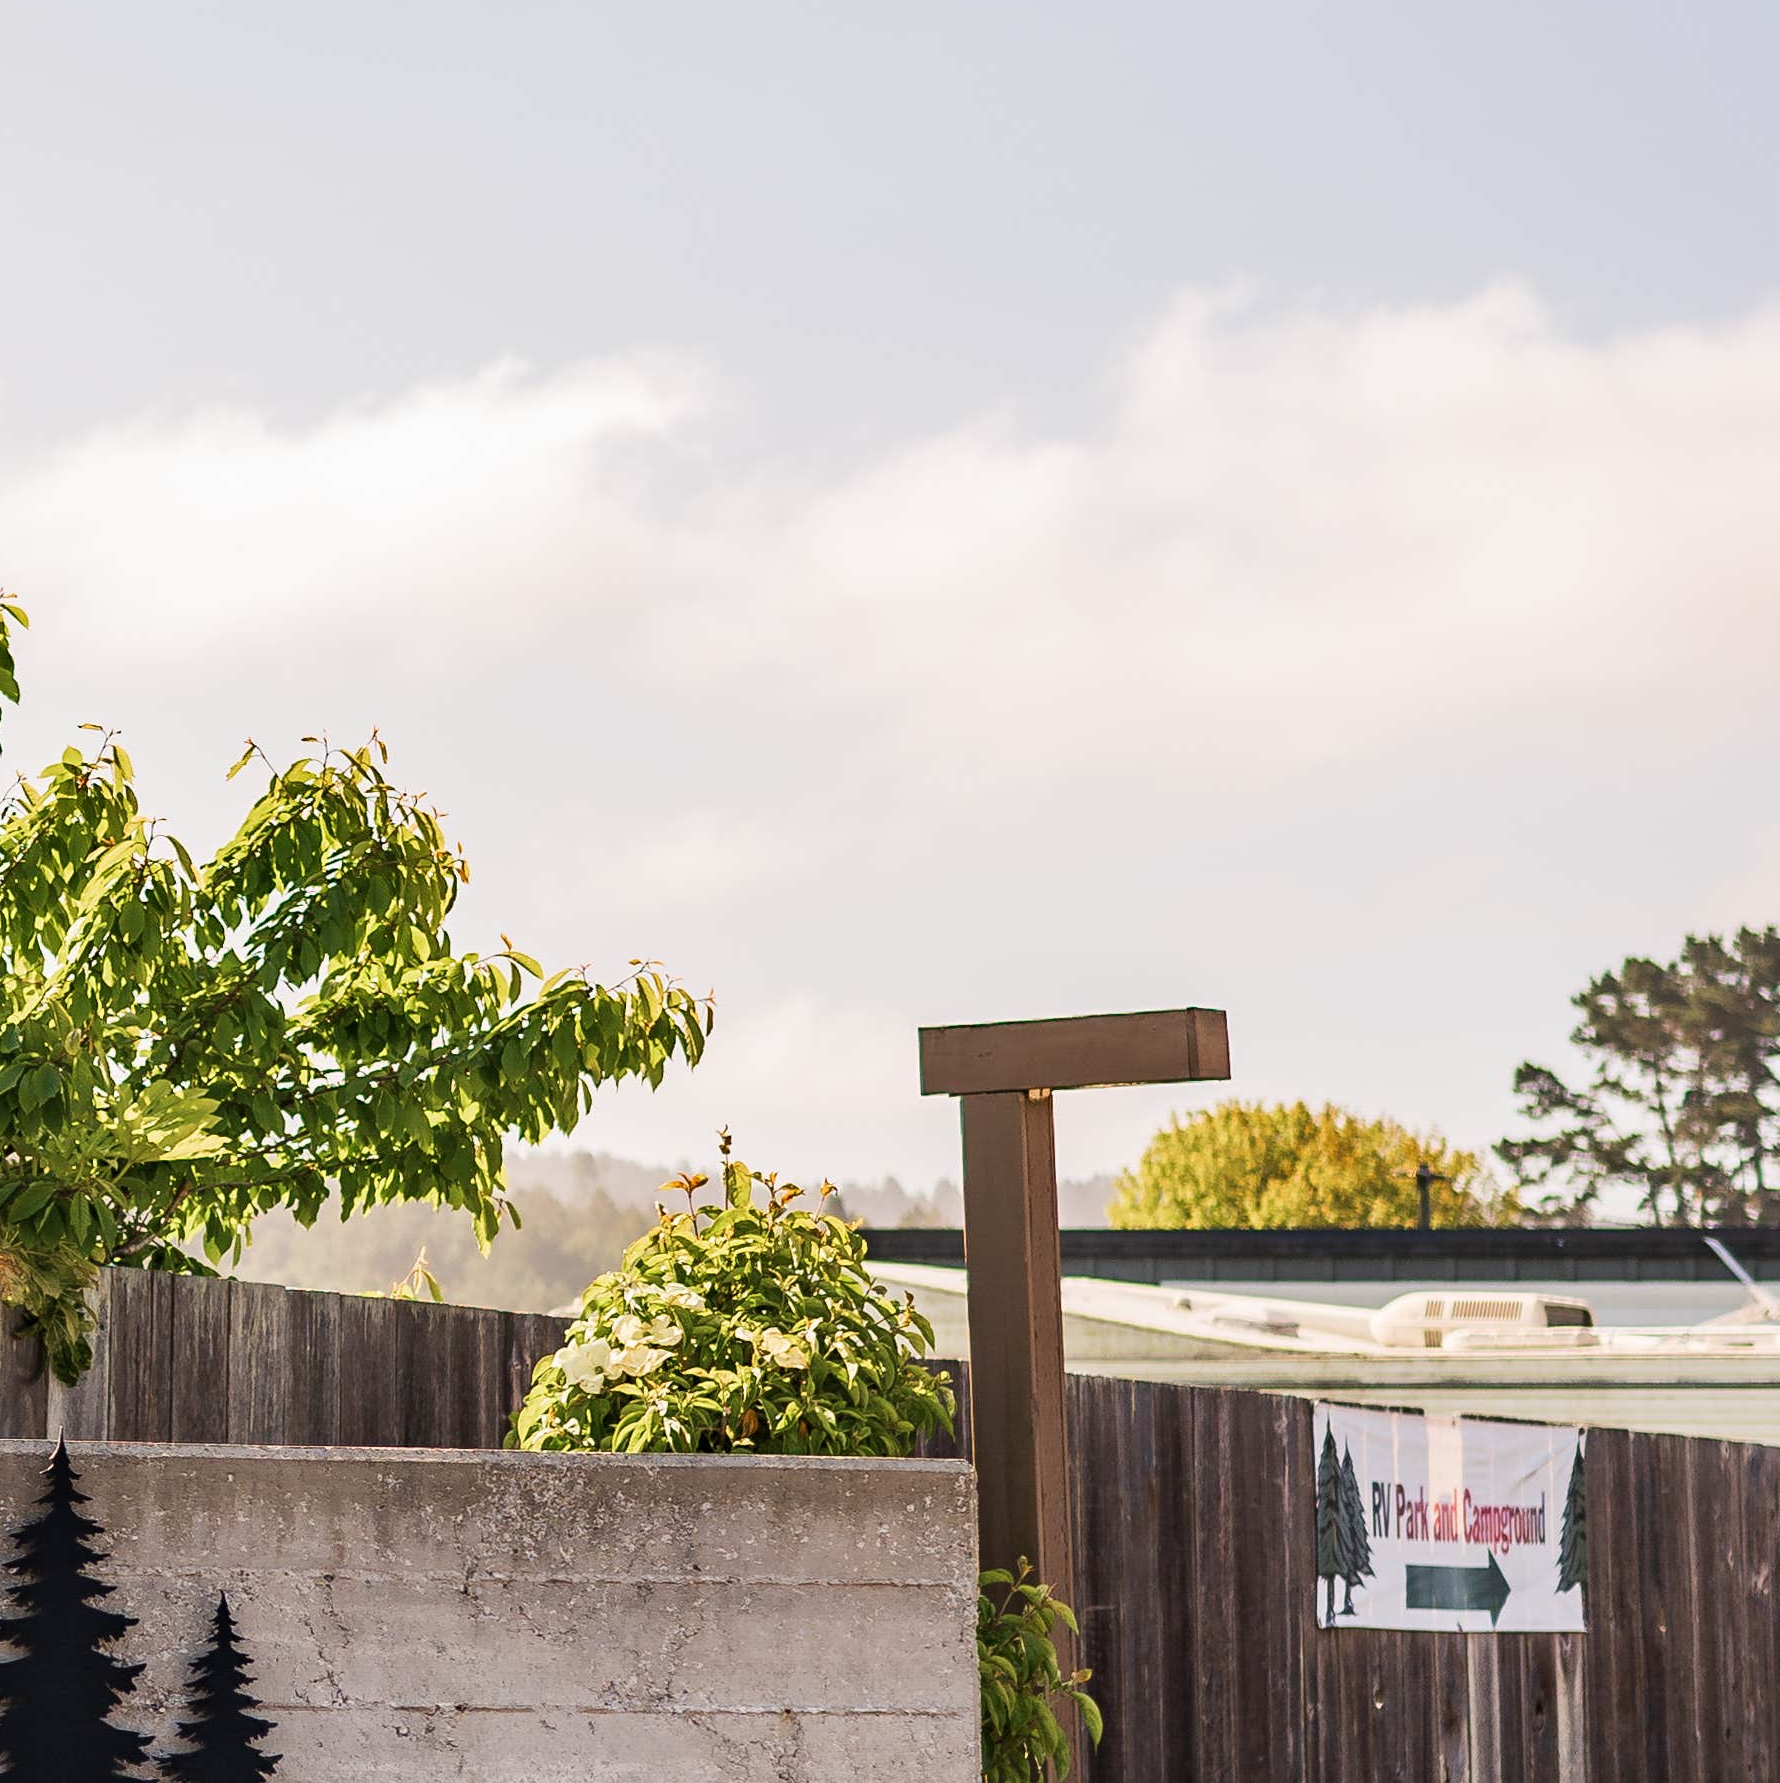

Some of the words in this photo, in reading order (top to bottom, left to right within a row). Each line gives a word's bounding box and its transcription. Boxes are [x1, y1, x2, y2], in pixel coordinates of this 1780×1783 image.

[1371, 1482, 1391, 1539] RV
[1395, 1484, 1429, 1542] Park
[1433, 1488, 1459, 1542] and
[1462, 1488, 1547, 1554] Campground
